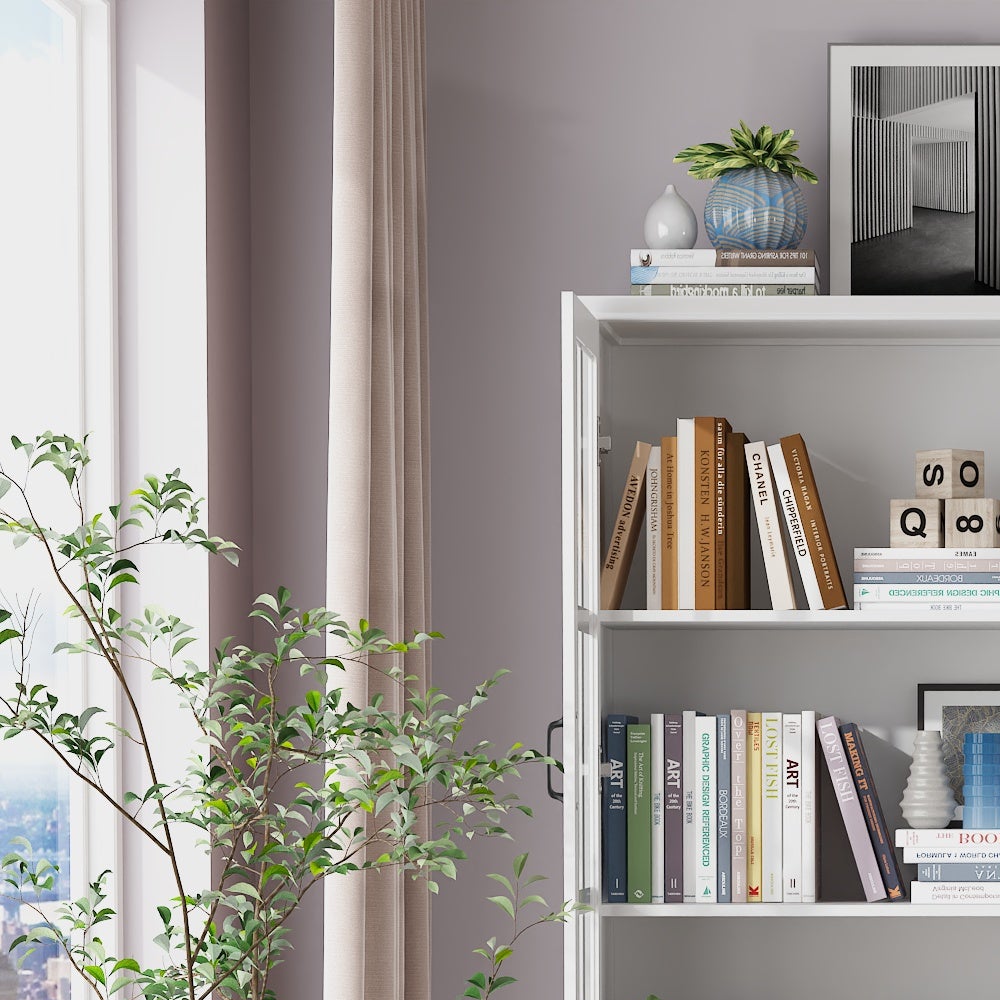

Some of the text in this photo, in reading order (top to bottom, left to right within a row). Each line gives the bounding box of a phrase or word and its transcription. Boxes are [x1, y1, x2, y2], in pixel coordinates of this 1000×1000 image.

[752, 454, 768, 505] CHANEL
[923, 464, 944, 486] S
[606, 476, 638, 570] AVEDON advertising
[783, 490, 806, 556] CHIPPERFIELD
[900, 508, 926, 538] Q
[956, 515, 983, 533] 8
[609, 759, 623, 788] ART
[667, 759, 680, 788] ART
[766, 719, 778, 798] LOST FISH
[787, 759, 798, 788] ART
[820, 722, 854, 802] LOST FISH
[844, 732, 868, 790] MAKING IT
[719, 790, 728, 838] BORDEAUX
